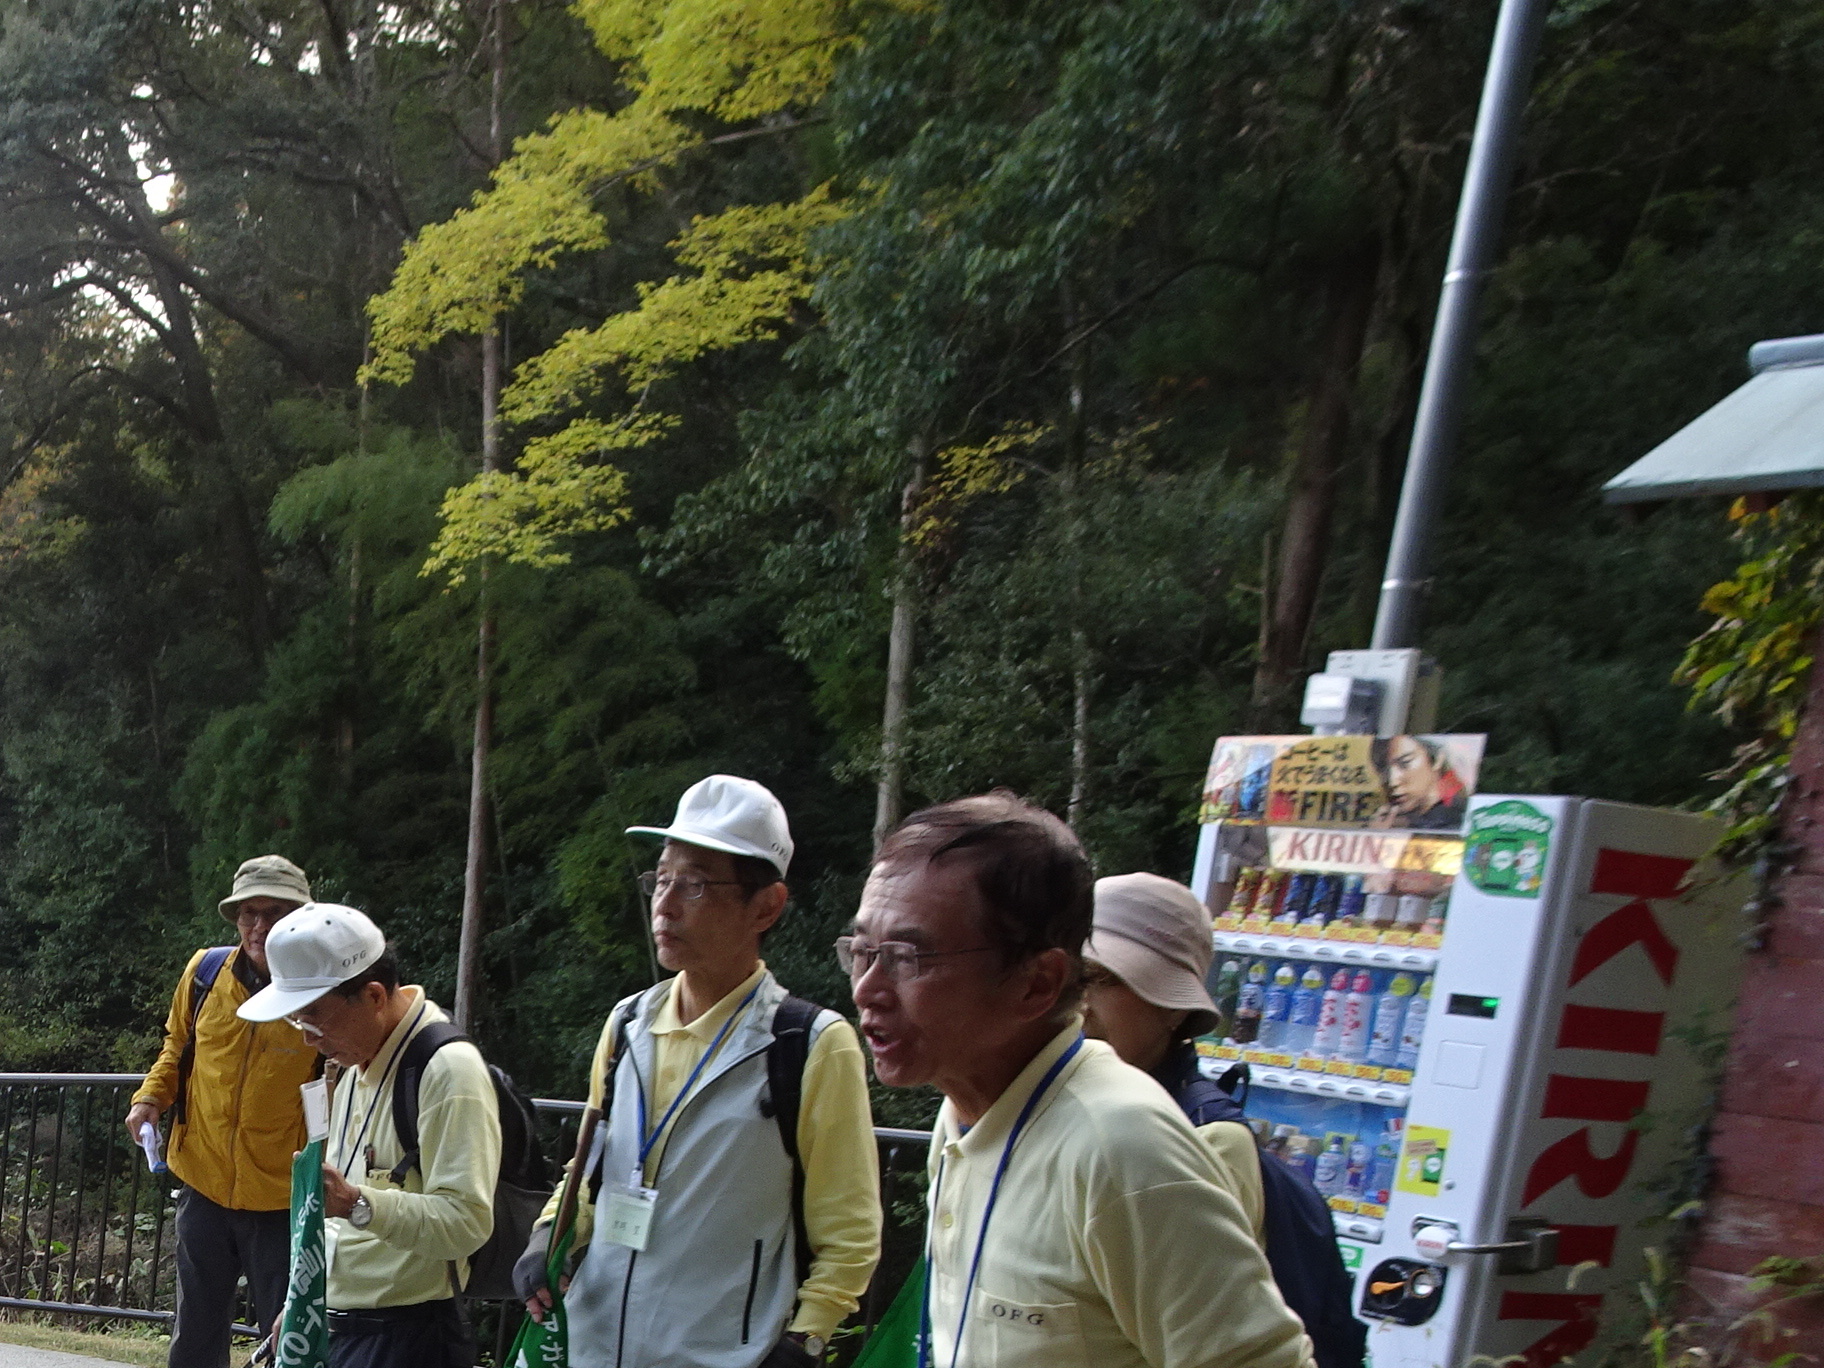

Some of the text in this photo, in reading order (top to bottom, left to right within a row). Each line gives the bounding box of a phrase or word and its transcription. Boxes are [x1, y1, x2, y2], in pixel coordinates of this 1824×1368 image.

[1299, 791, 1376, 822] FIRE
[1285, 829, 1386, 864] KIRIN
[342, 949, 367, 968] OFG
[992, 1304, 1044, 1325] OFG
